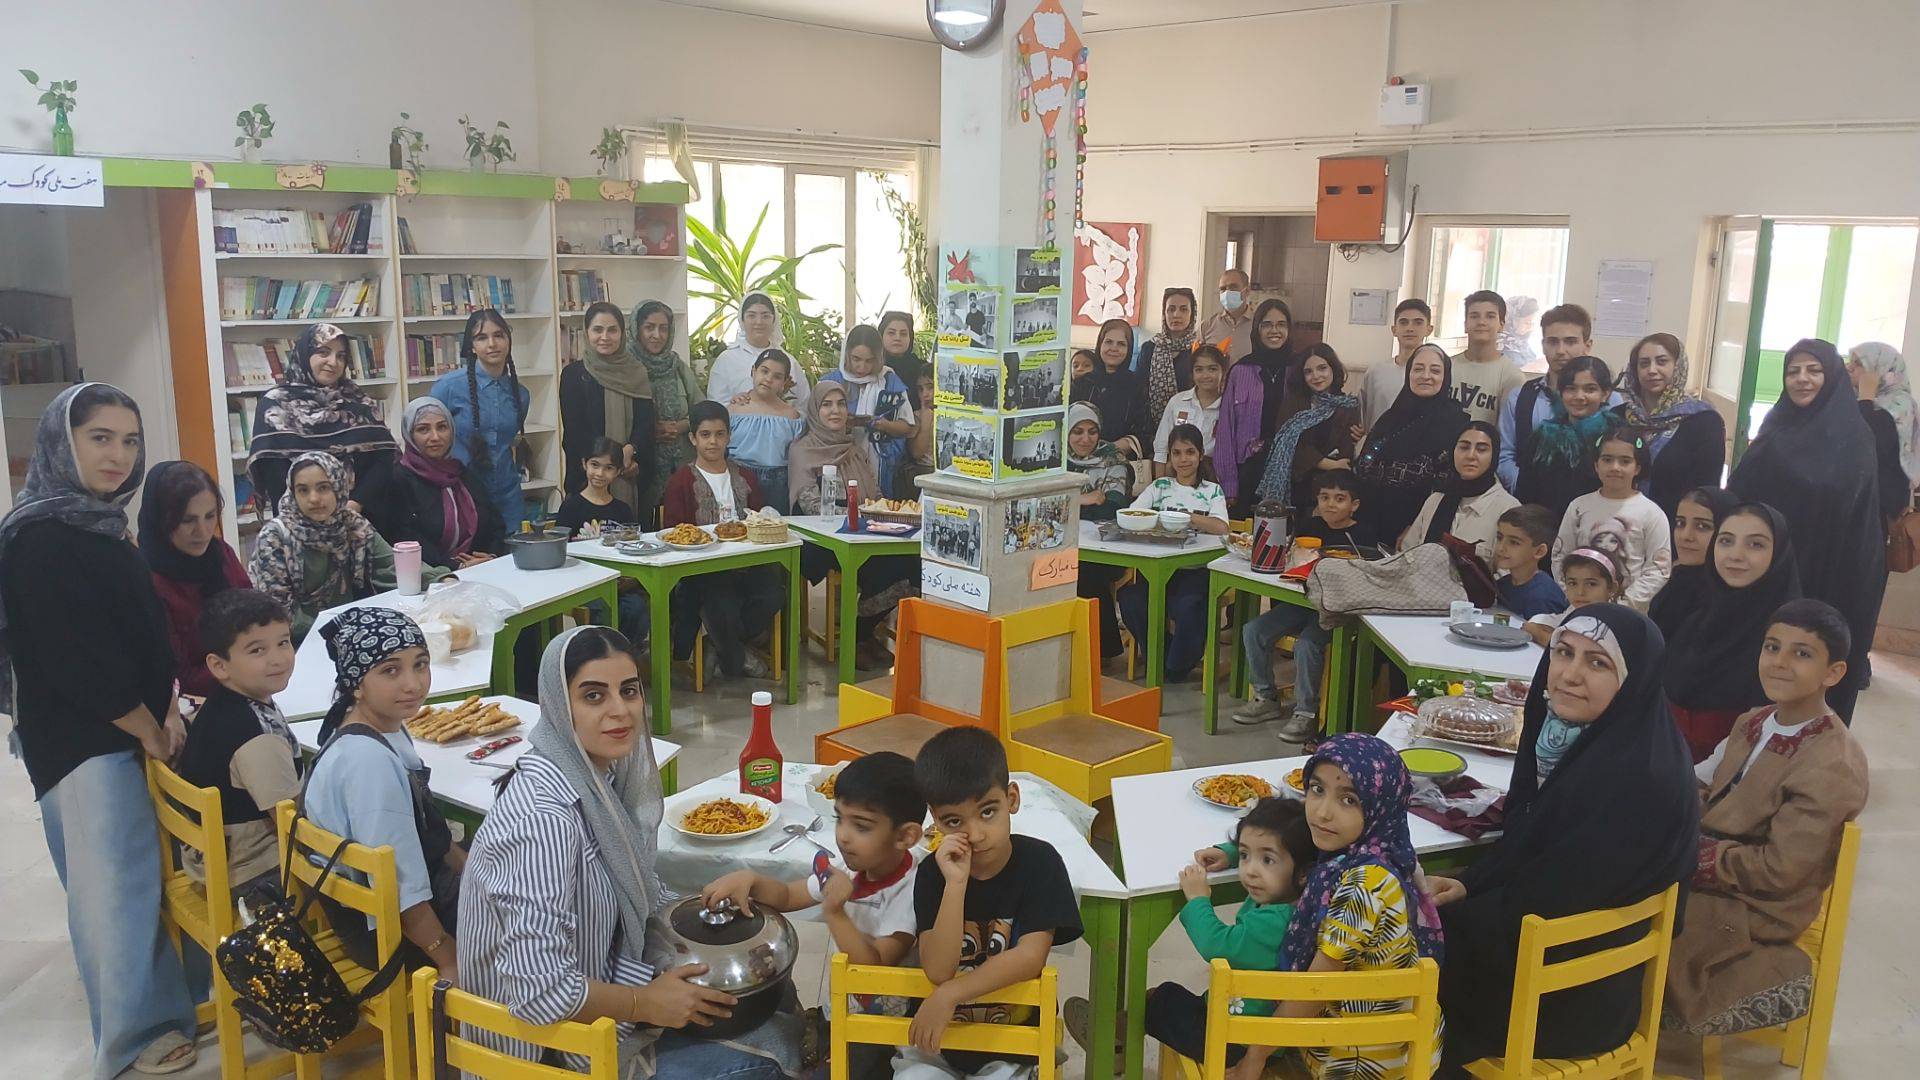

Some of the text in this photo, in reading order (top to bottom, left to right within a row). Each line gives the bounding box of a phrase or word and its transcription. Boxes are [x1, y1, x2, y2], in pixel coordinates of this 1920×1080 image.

[7, 163, 56, 188] کودک
[1038, 558, 1069, 579] مبارک
[942, 576, 959, 592] ملی
[961, 582, 981, 598] هفته
